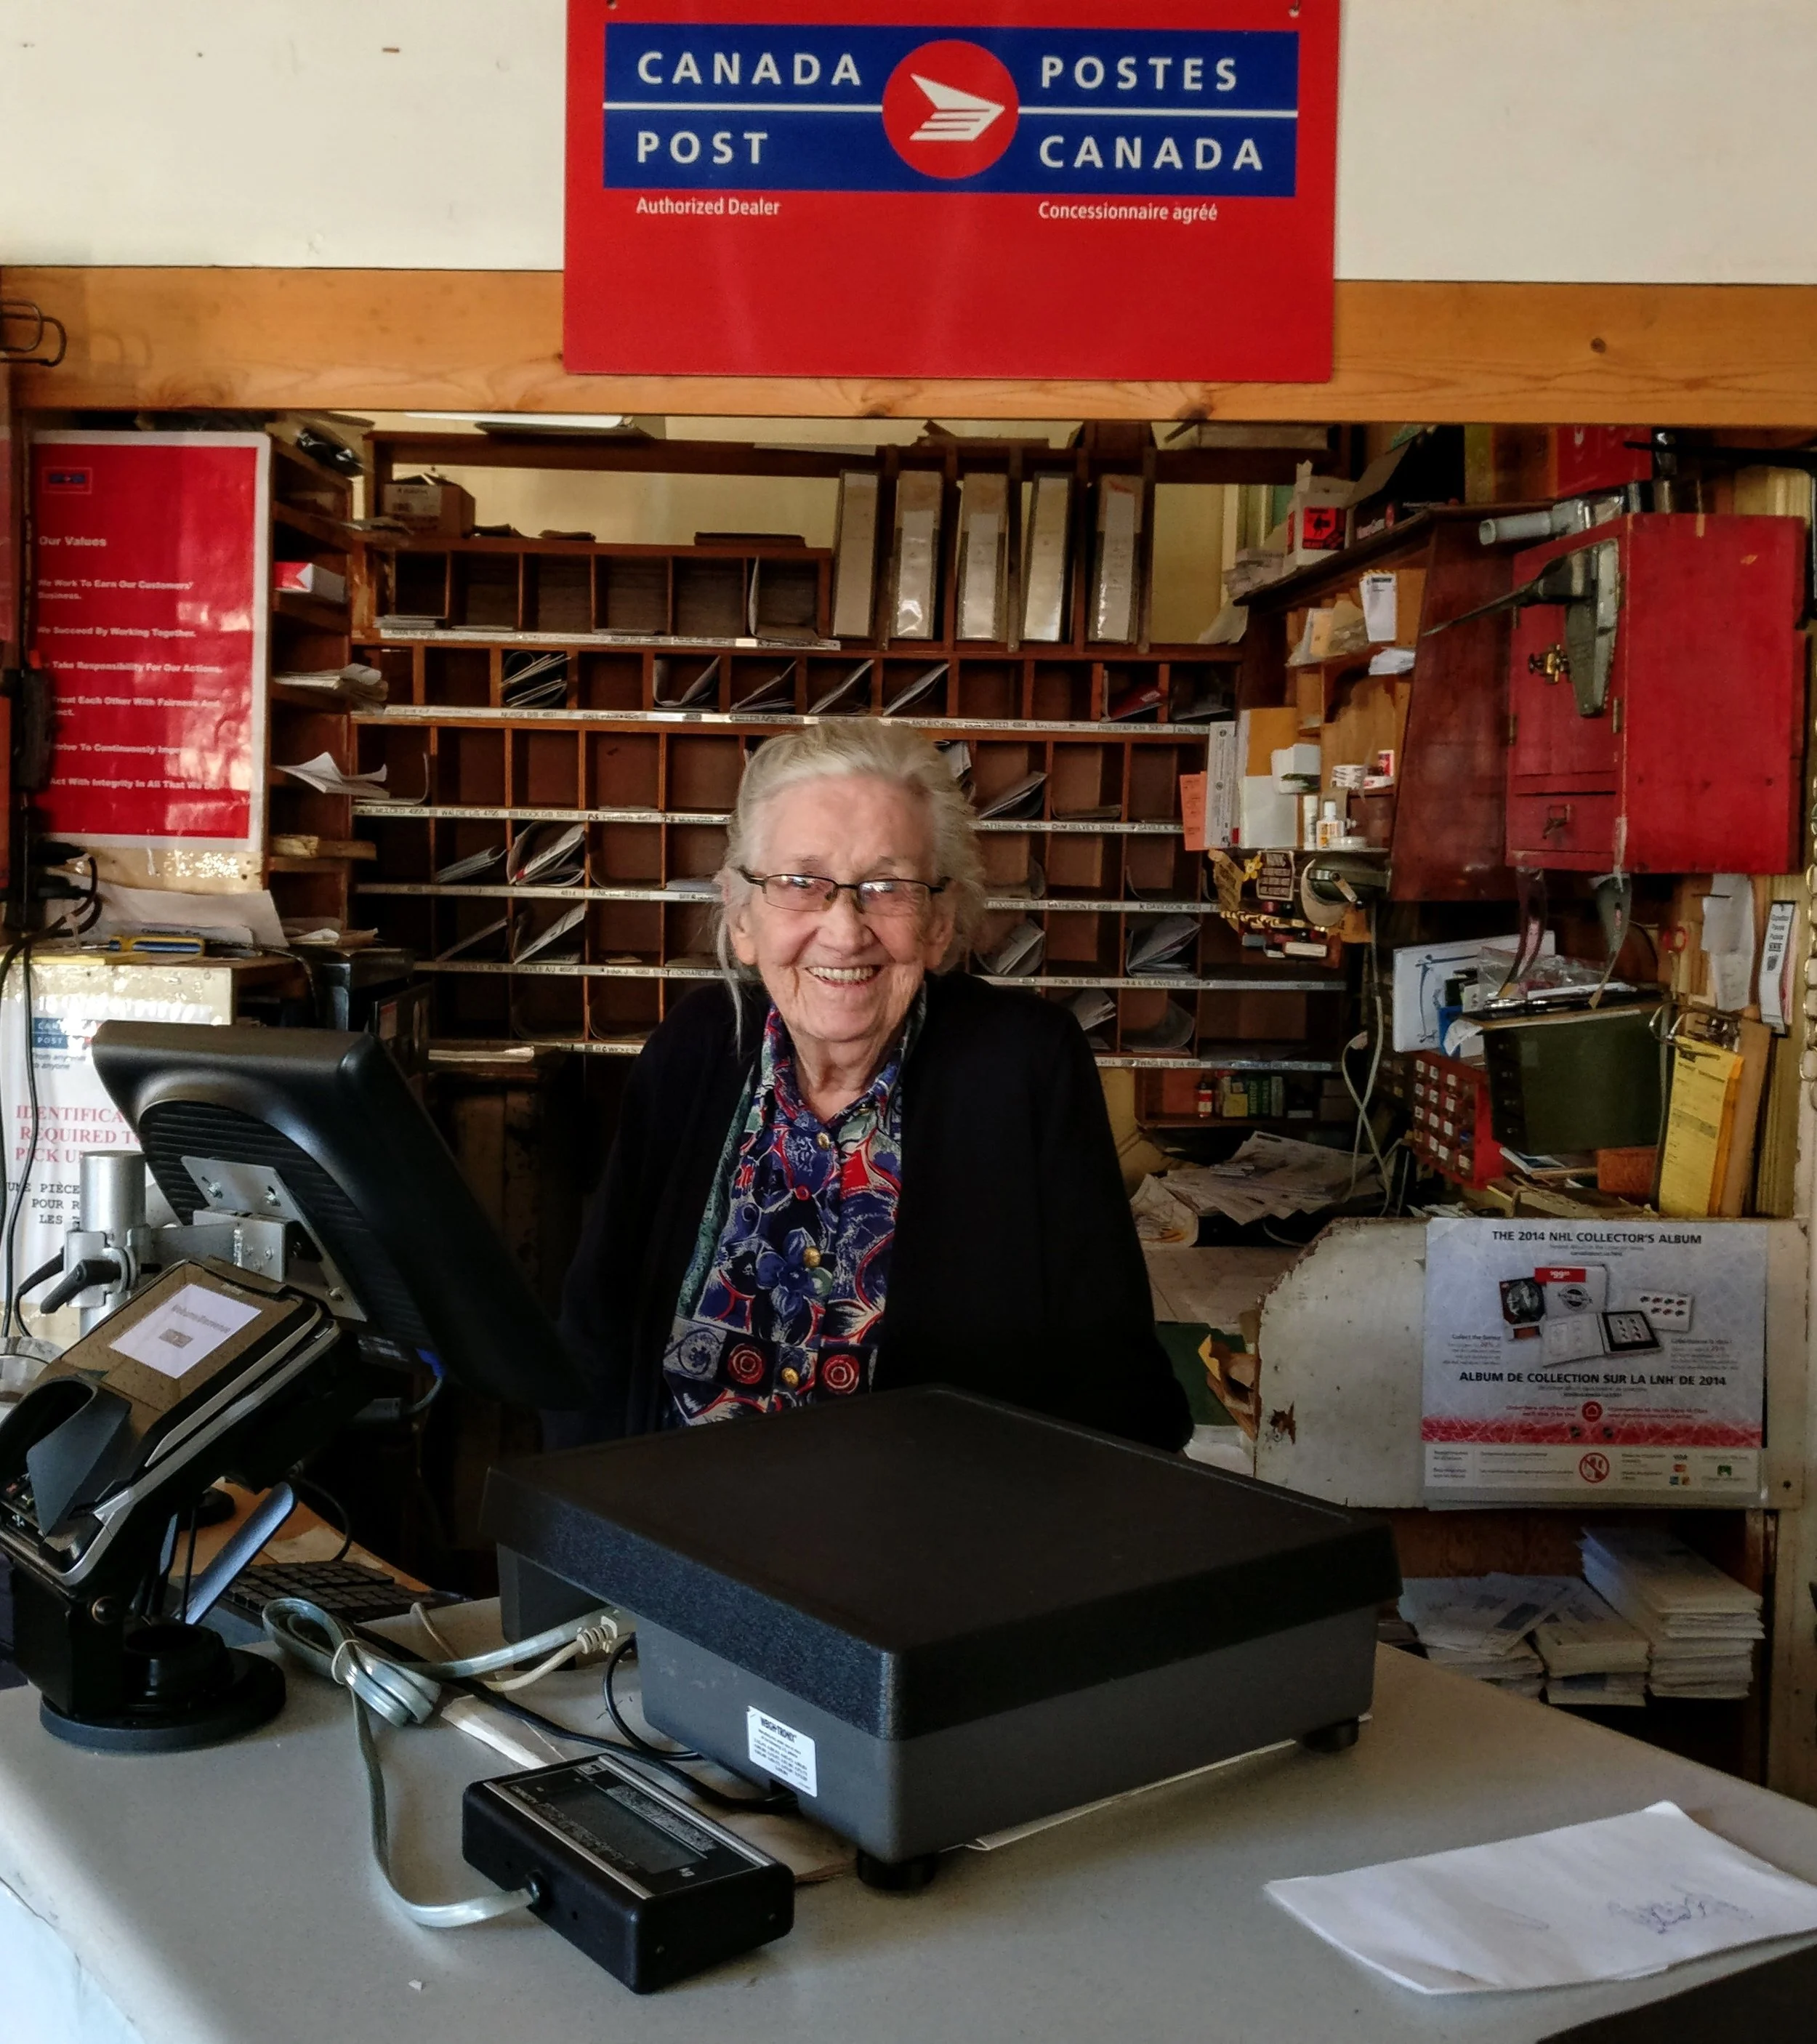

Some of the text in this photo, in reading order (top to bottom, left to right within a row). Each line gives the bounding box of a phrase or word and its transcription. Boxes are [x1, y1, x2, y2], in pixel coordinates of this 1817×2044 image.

[637, 50, 862, 86] CANADA
[1040, 56, 1238, 93] POSTES
[637, 132, 768, 166] POST
[1039, 137, 1264, 172] CANADA
[636, 197, 781, 217] Authorized Dealer
[1039, 201, 1218, 224] Concessionnaire agréé
[39, 536, 107, 547] Our Values
[95, 627, 108, 637] By
[110, 628, 150, 637] Working
[77, 661, 144, 672] Responsibility
[40, 1181, 80, 1194] PIÈCE
[31, 1199, 64, 1209] POUR
[39, 1215, 63, 1224] LES
[1491, 1231, 1702, 1244] THE 2014 NHL COLLECTOR'S ALBUM
[1459, 1372, 1726, 1385] ALBUM DE COLLECTION SUR LA LNH DE 2014
